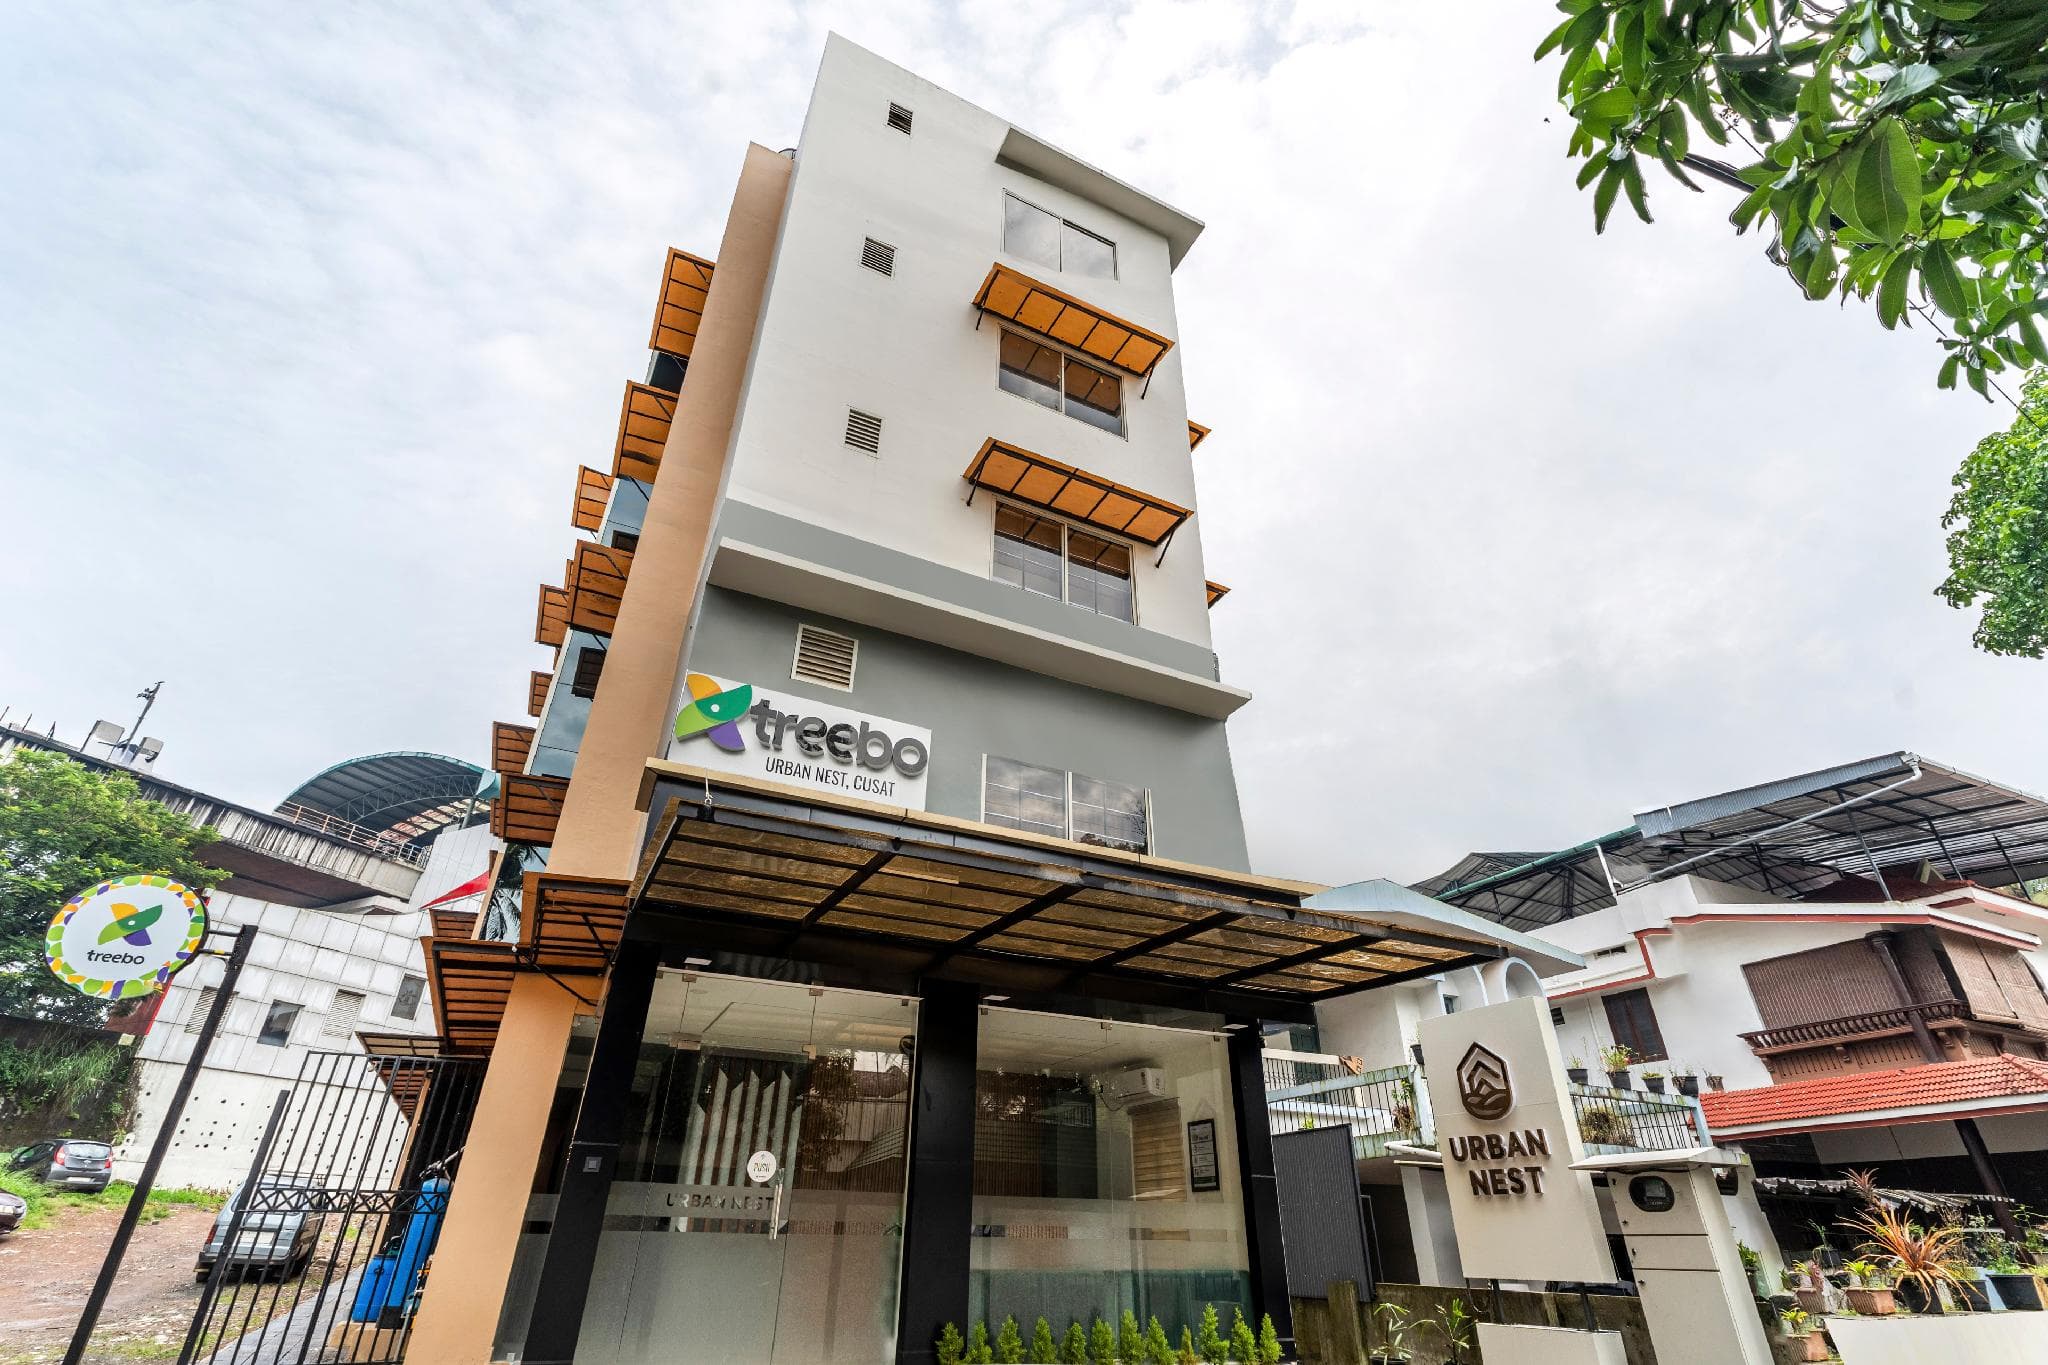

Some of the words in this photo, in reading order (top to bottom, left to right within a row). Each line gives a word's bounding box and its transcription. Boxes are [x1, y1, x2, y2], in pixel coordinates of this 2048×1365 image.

[749, 699, 928, 777] treebo
[765, 756, 812, 781] URBAN
[815, 767, 849, 790] NEST,
[853, 775, 895, 797] CUSAT
[87, 949, 145, 965] treebo
[1448, 1128, 1551, 1162] URBAN
[1469, 1166, 1544, 1195] NEST
[666, 1192, 726, 1210] URBAN
[730, 1196, 775, 1211] NEST
